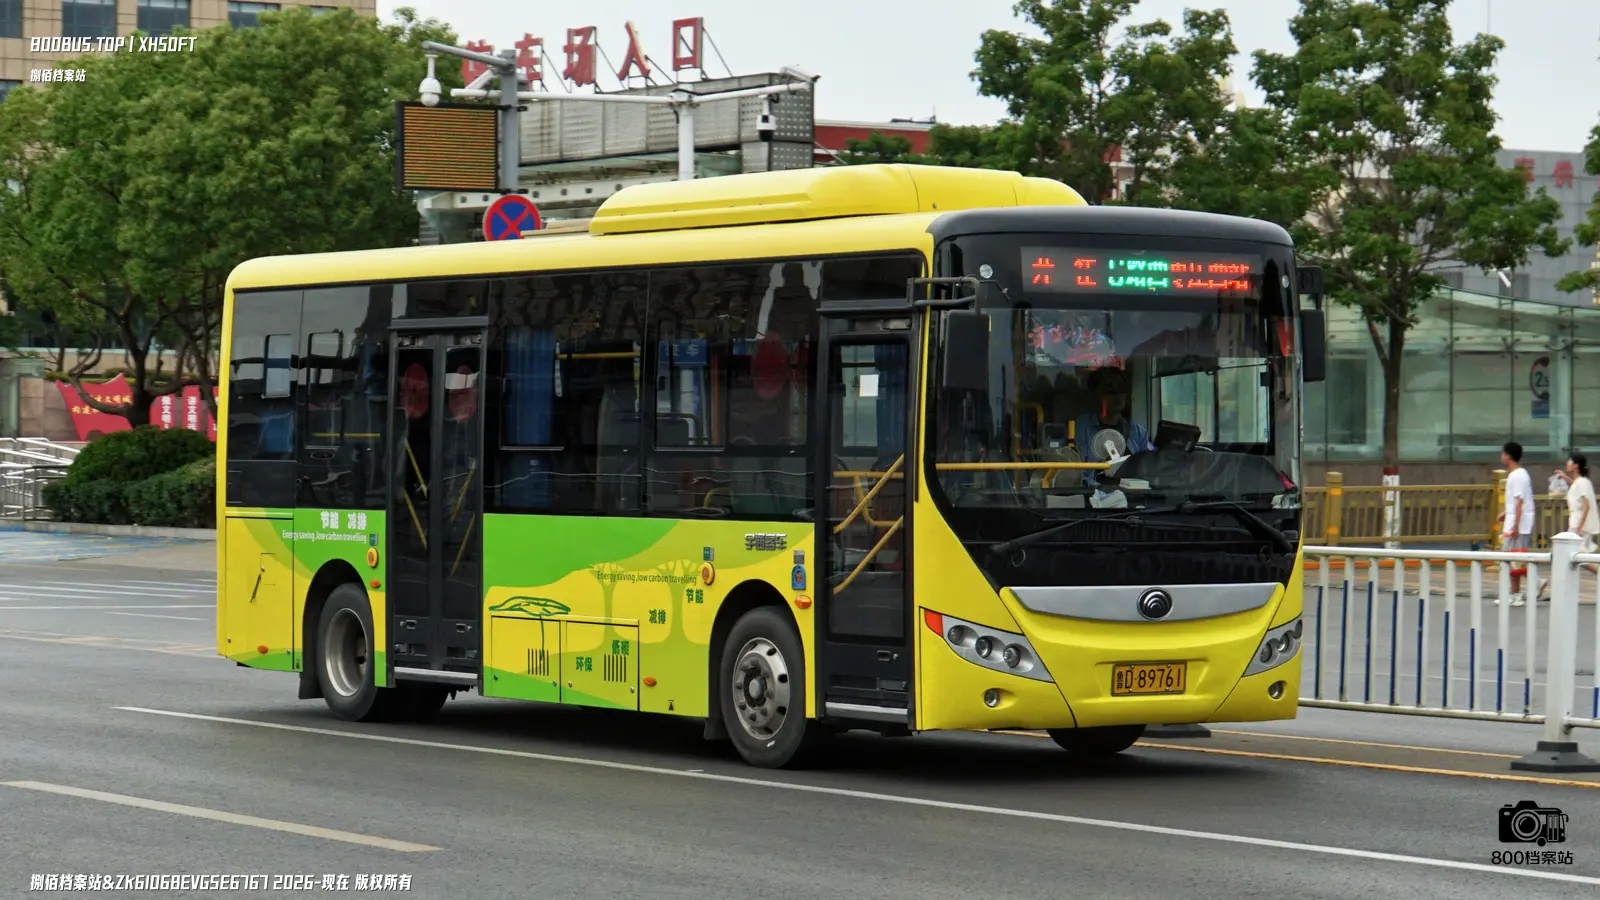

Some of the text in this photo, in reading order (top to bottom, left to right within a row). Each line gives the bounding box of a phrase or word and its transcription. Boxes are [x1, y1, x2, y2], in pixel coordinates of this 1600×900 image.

[744, 533, 787, 551] 宇通客车
[596, 571, 616, 582] Energy
[616, 573, 635, 583] saving
[648, 573, 668, 583] carbon
[669, 574, 697, 586] travelling
[686, 588, 704, 604] 节能
[648, 609, 667, 625] 减排
[612, 640, 630, 656] 低碳
[575, 656, 593, 672] 环保
